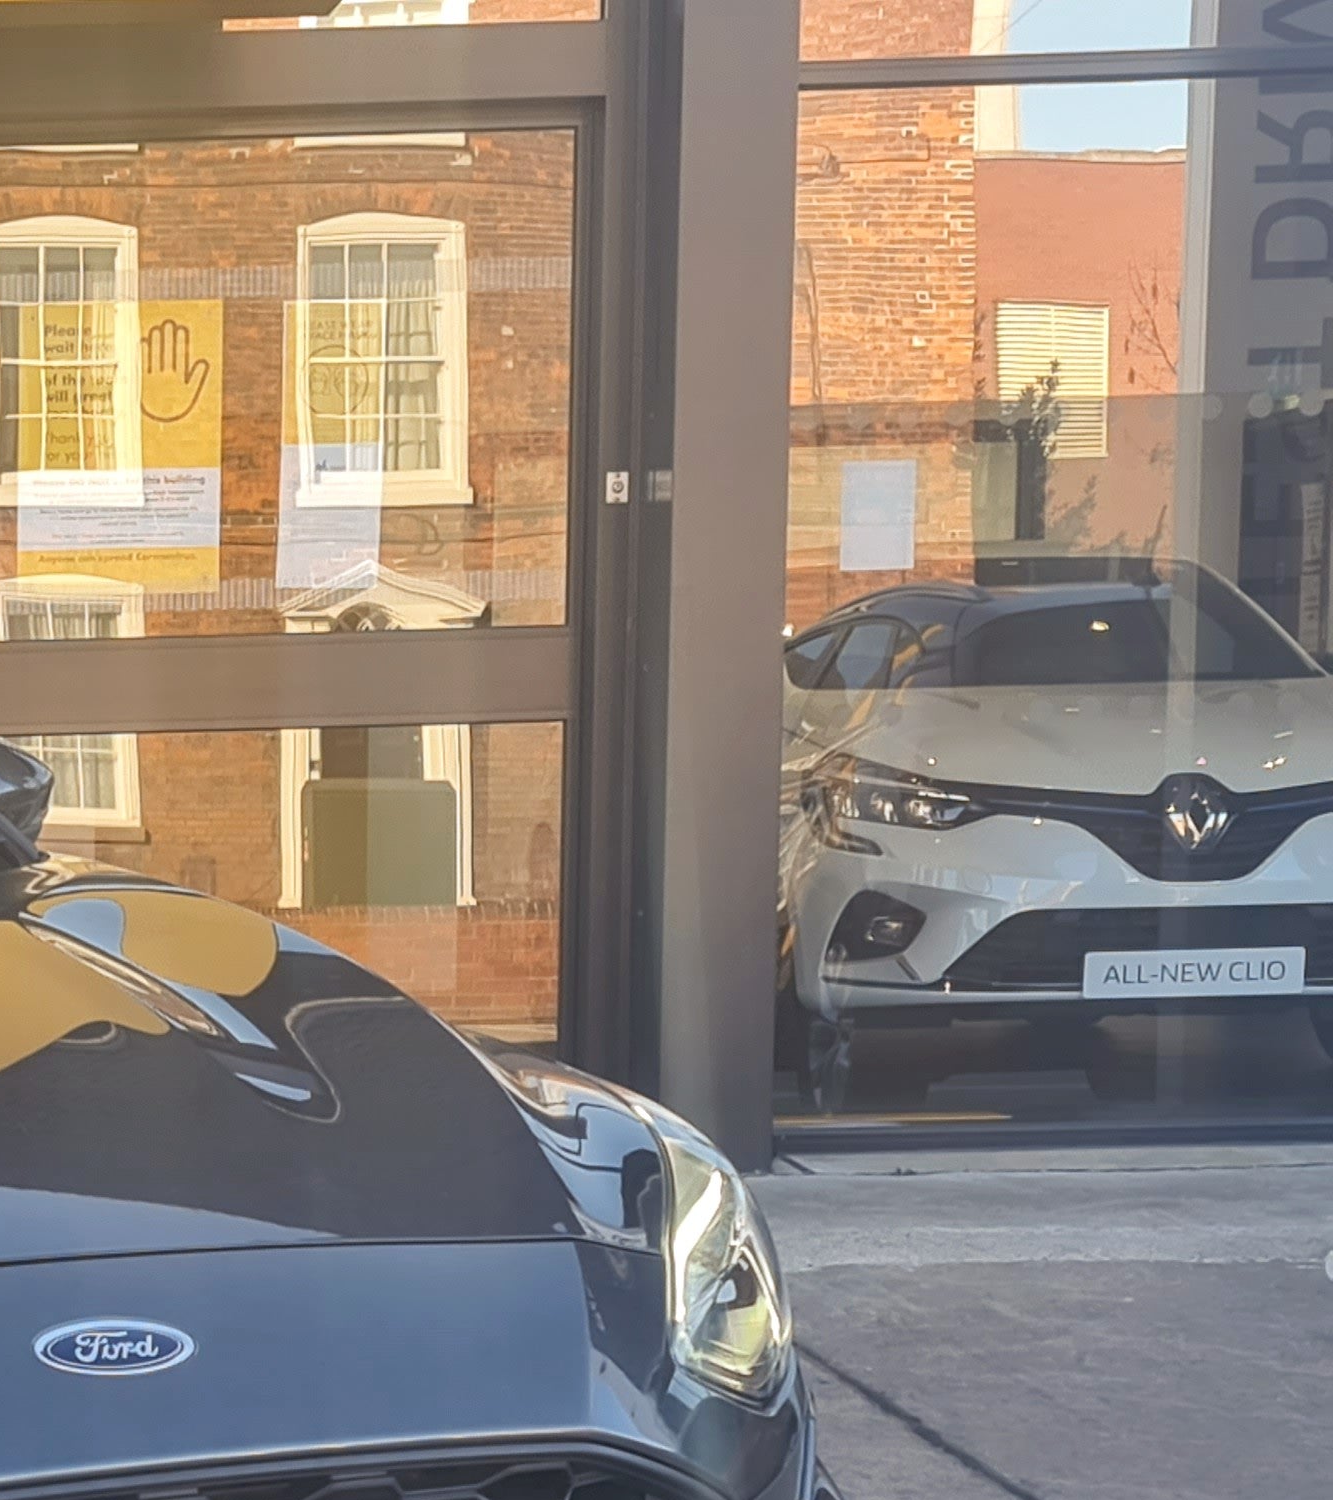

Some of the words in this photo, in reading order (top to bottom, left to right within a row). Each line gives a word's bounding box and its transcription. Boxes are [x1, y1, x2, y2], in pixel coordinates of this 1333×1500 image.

[1103, 962, 1222, 985] ALL-NEW
[1229, 960, 1286, 982] CLIO
[75, 1330, 159, 1362] Ford
